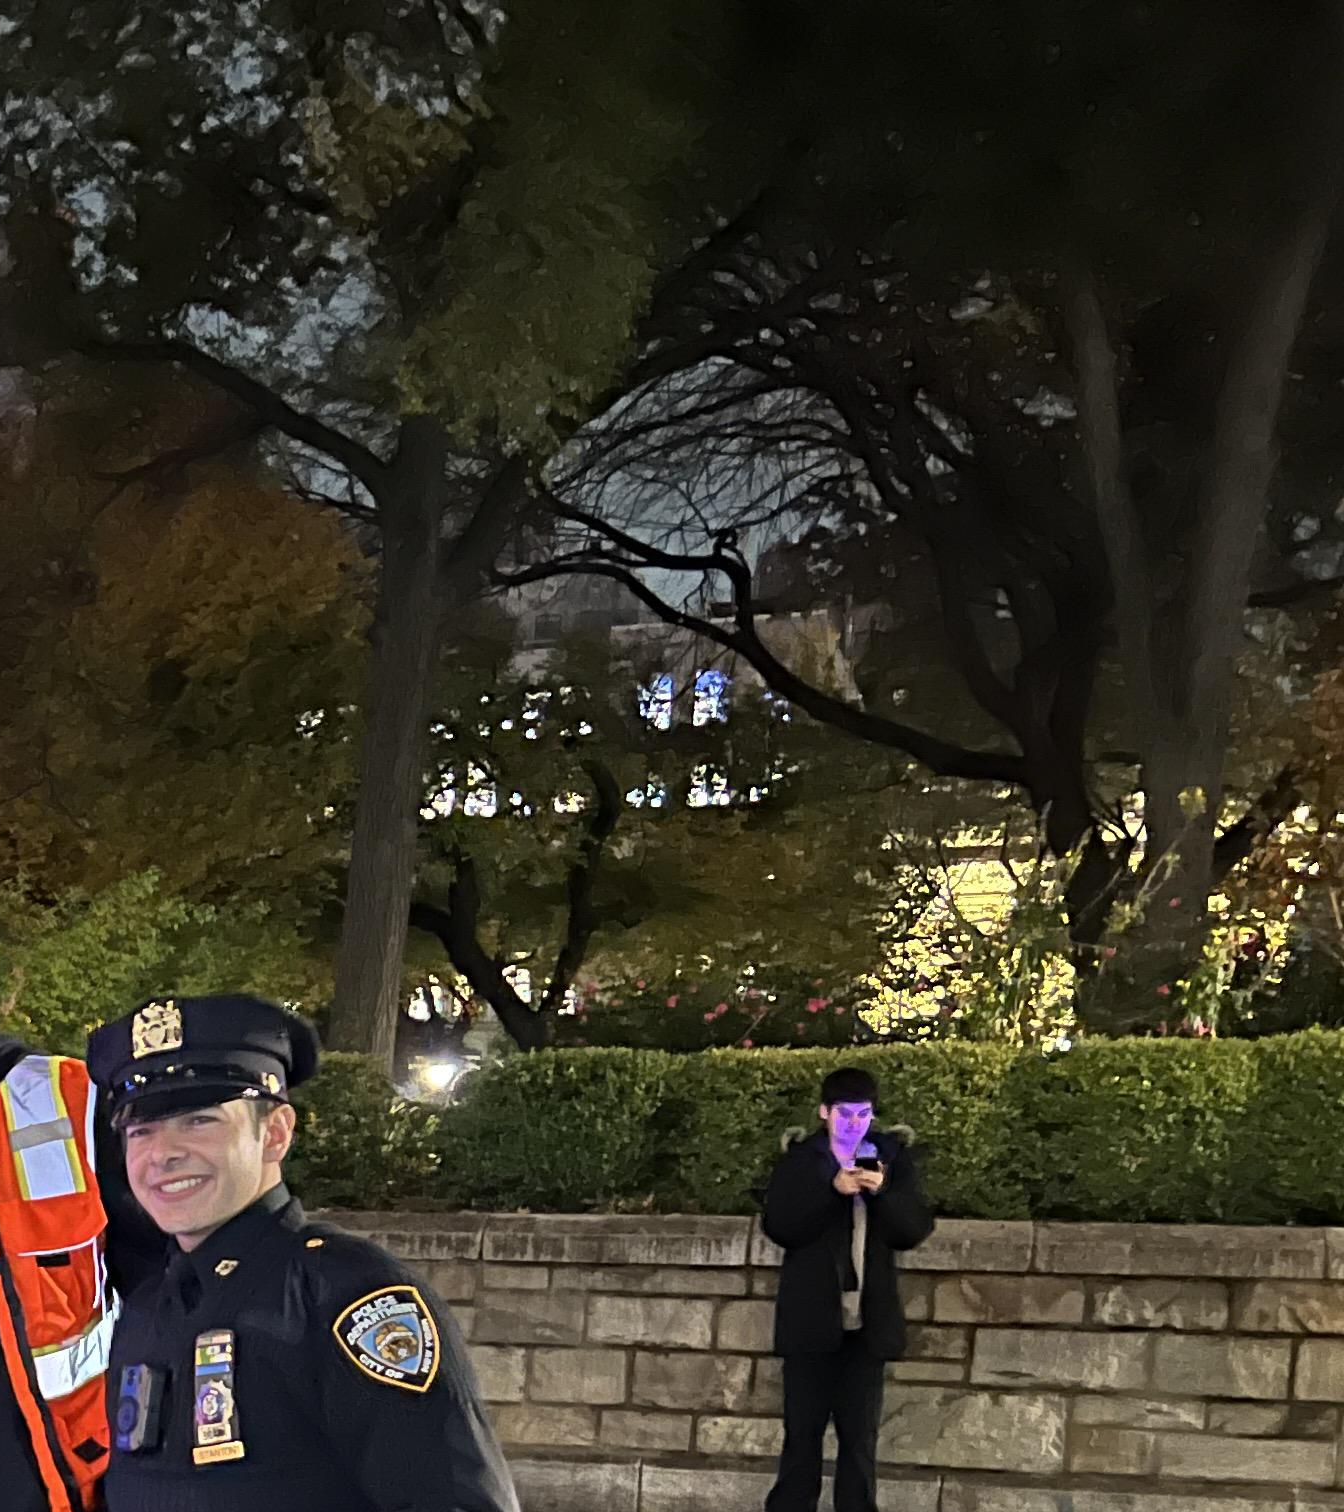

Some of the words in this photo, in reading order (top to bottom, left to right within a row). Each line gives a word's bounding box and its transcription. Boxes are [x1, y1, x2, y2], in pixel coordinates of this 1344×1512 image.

[351, 1295, 399, 1323] POLICE
[346, 1303, 418, 1346] DEPARTMENT
[359, 1353, 385, 1373] CITY
[385, 1368, 405, 1379] OF
